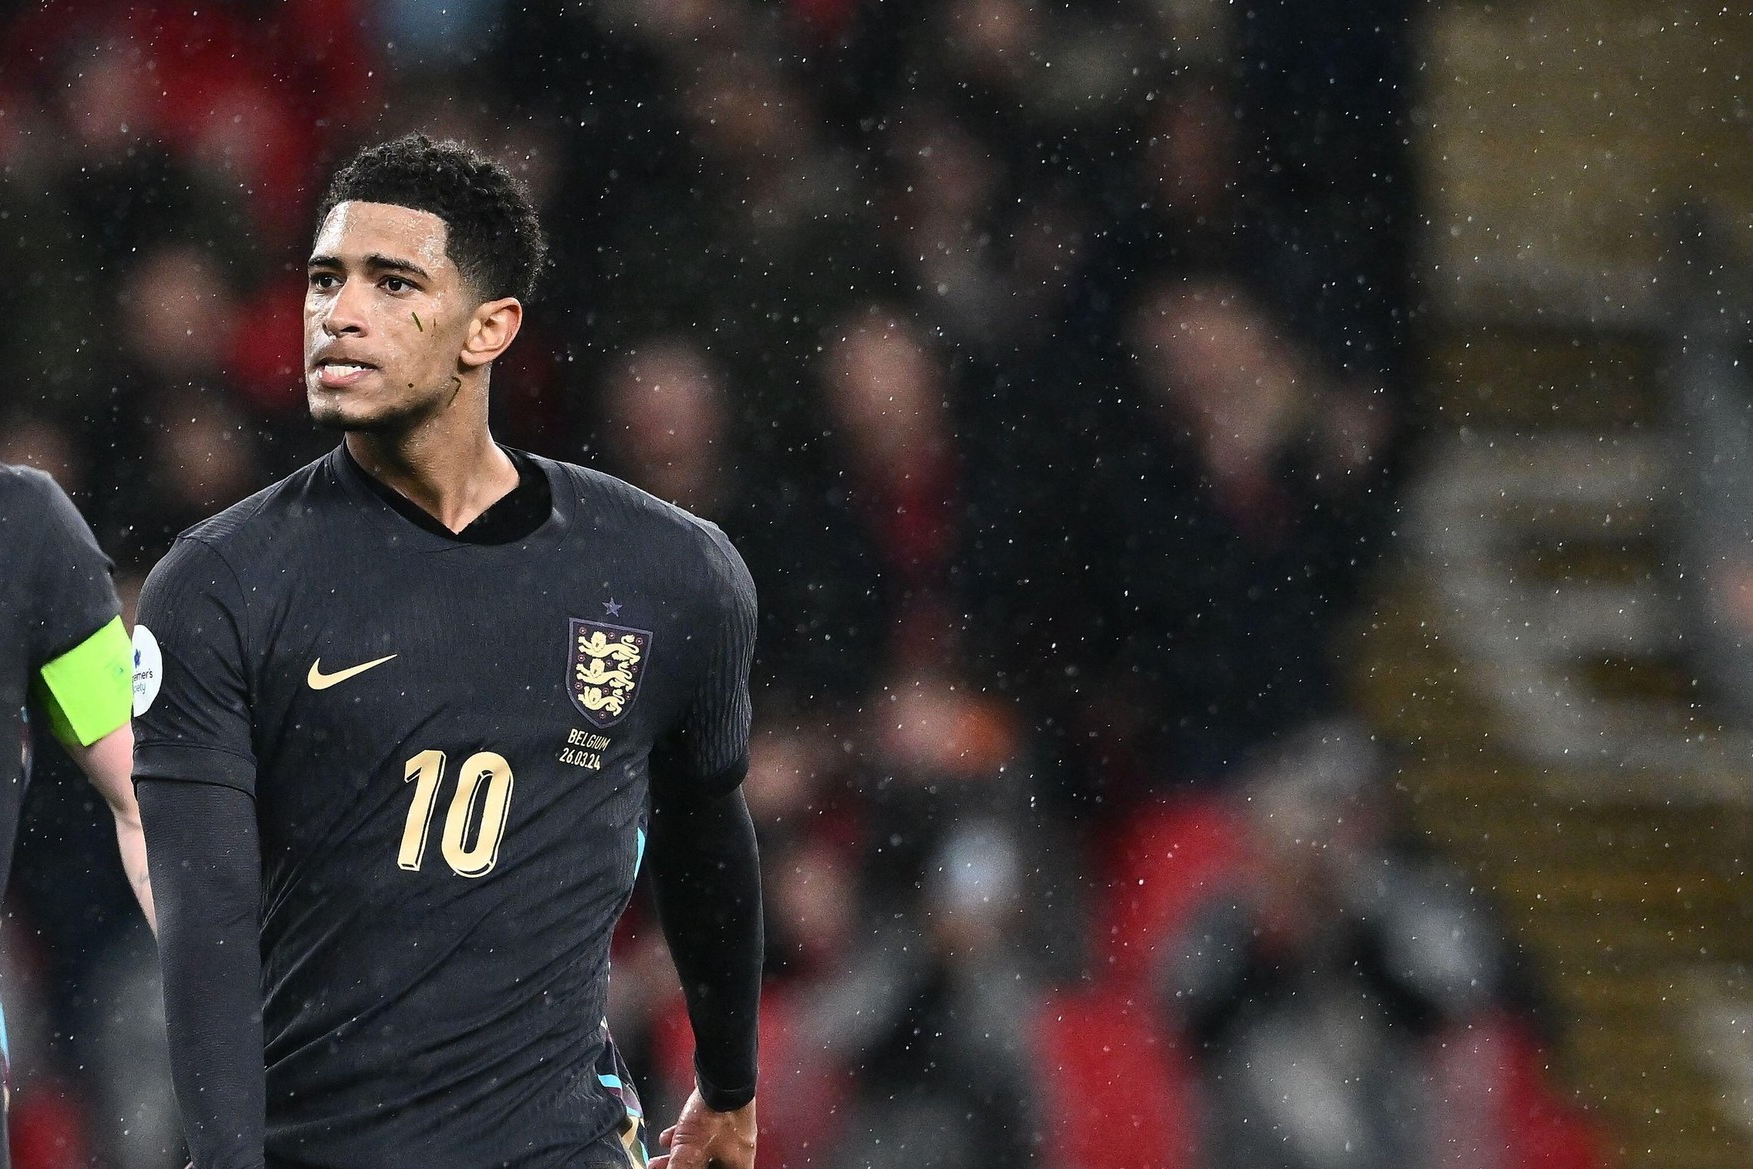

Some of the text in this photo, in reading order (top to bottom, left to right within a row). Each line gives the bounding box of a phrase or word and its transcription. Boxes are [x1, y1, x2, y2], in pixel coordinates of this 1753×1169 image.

[567, 728, 612, 751] BELGIUM
[559, 747, 601, 771] 26.03.24
[397, 750, 514, 878] 10
